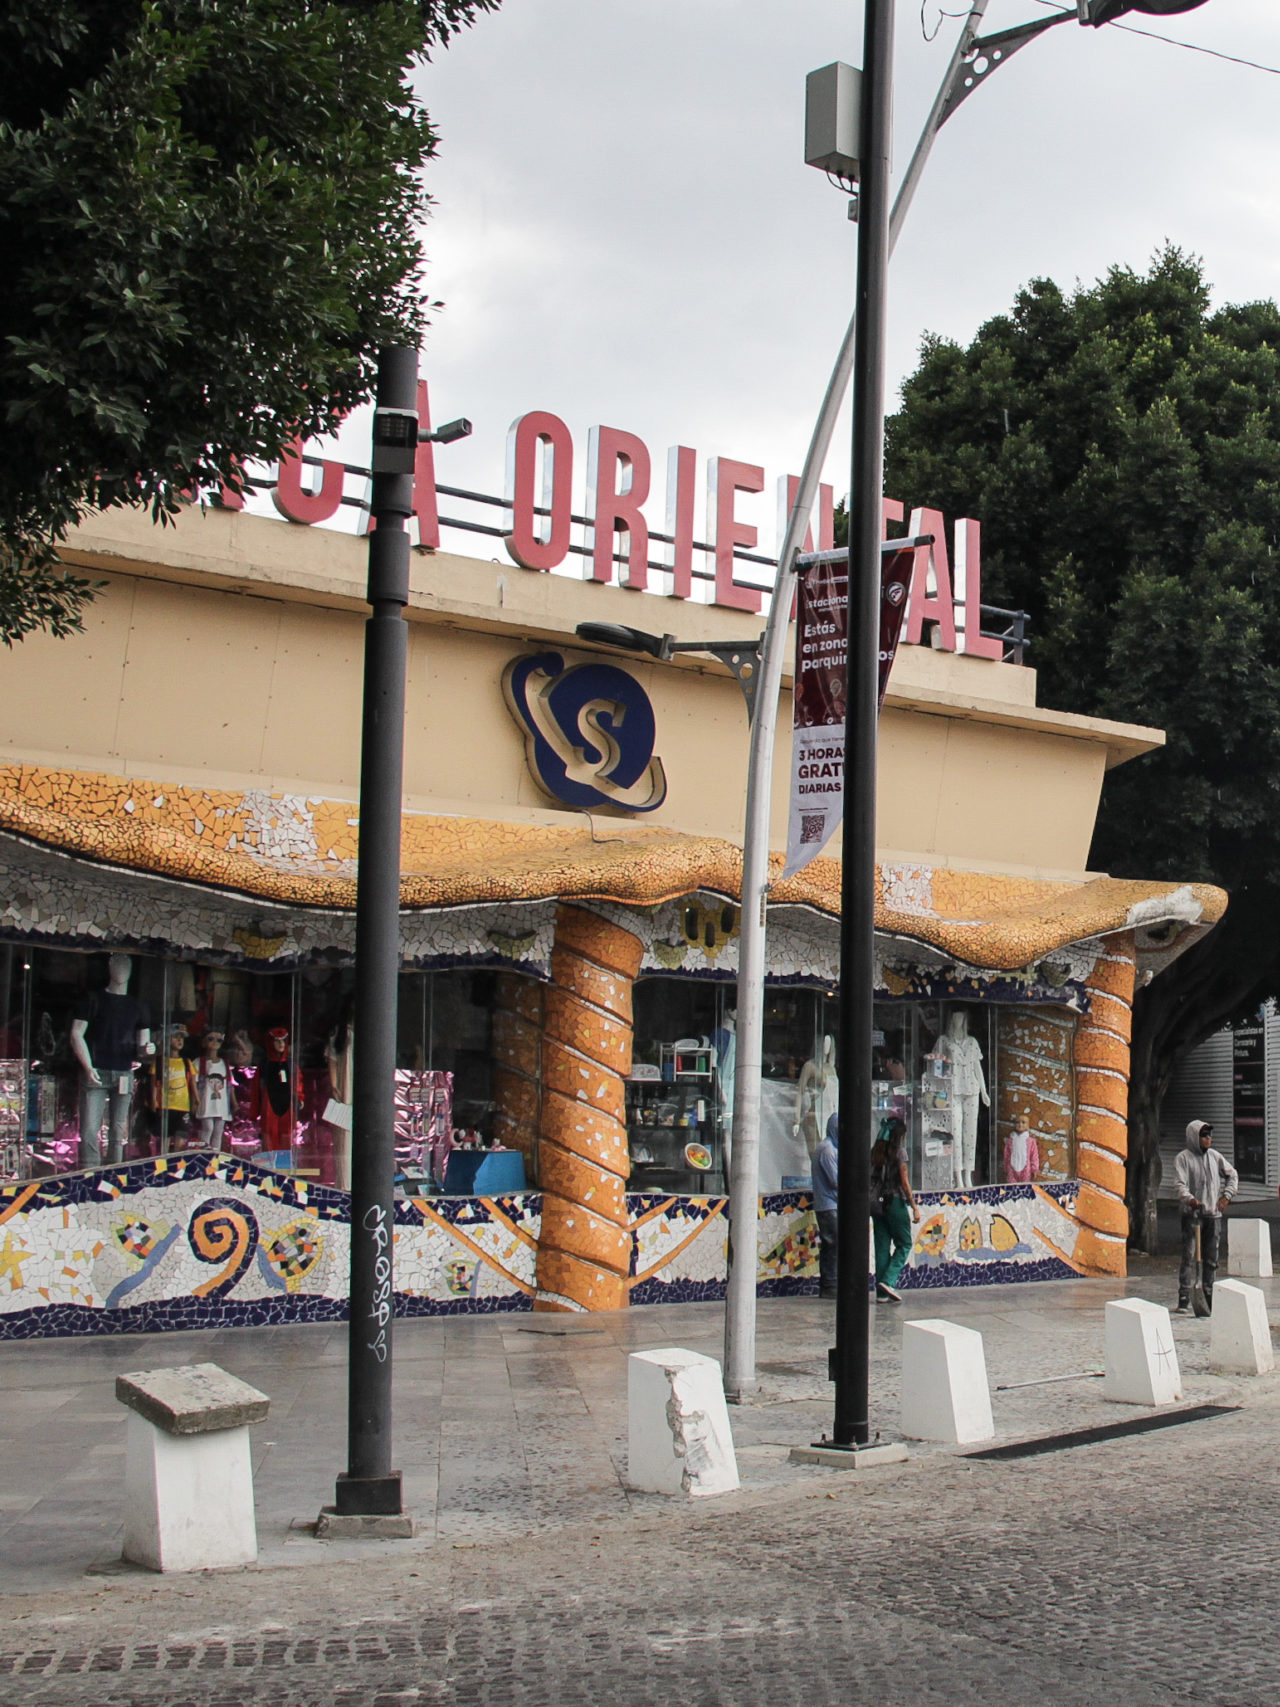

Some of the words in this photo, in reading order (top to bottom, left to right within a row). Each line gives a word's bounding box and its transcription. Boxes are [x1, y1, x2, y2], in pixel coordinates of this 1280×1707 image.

[804, 620, 836, 637] Estás
[802, 644, 818, 654] en
[799, 750, 805, 761] 3
[807, 747, 845, 760] HORA
[799, 762, 845, 779] GRATI
[799, 783, 842, 794] DIARIAS
